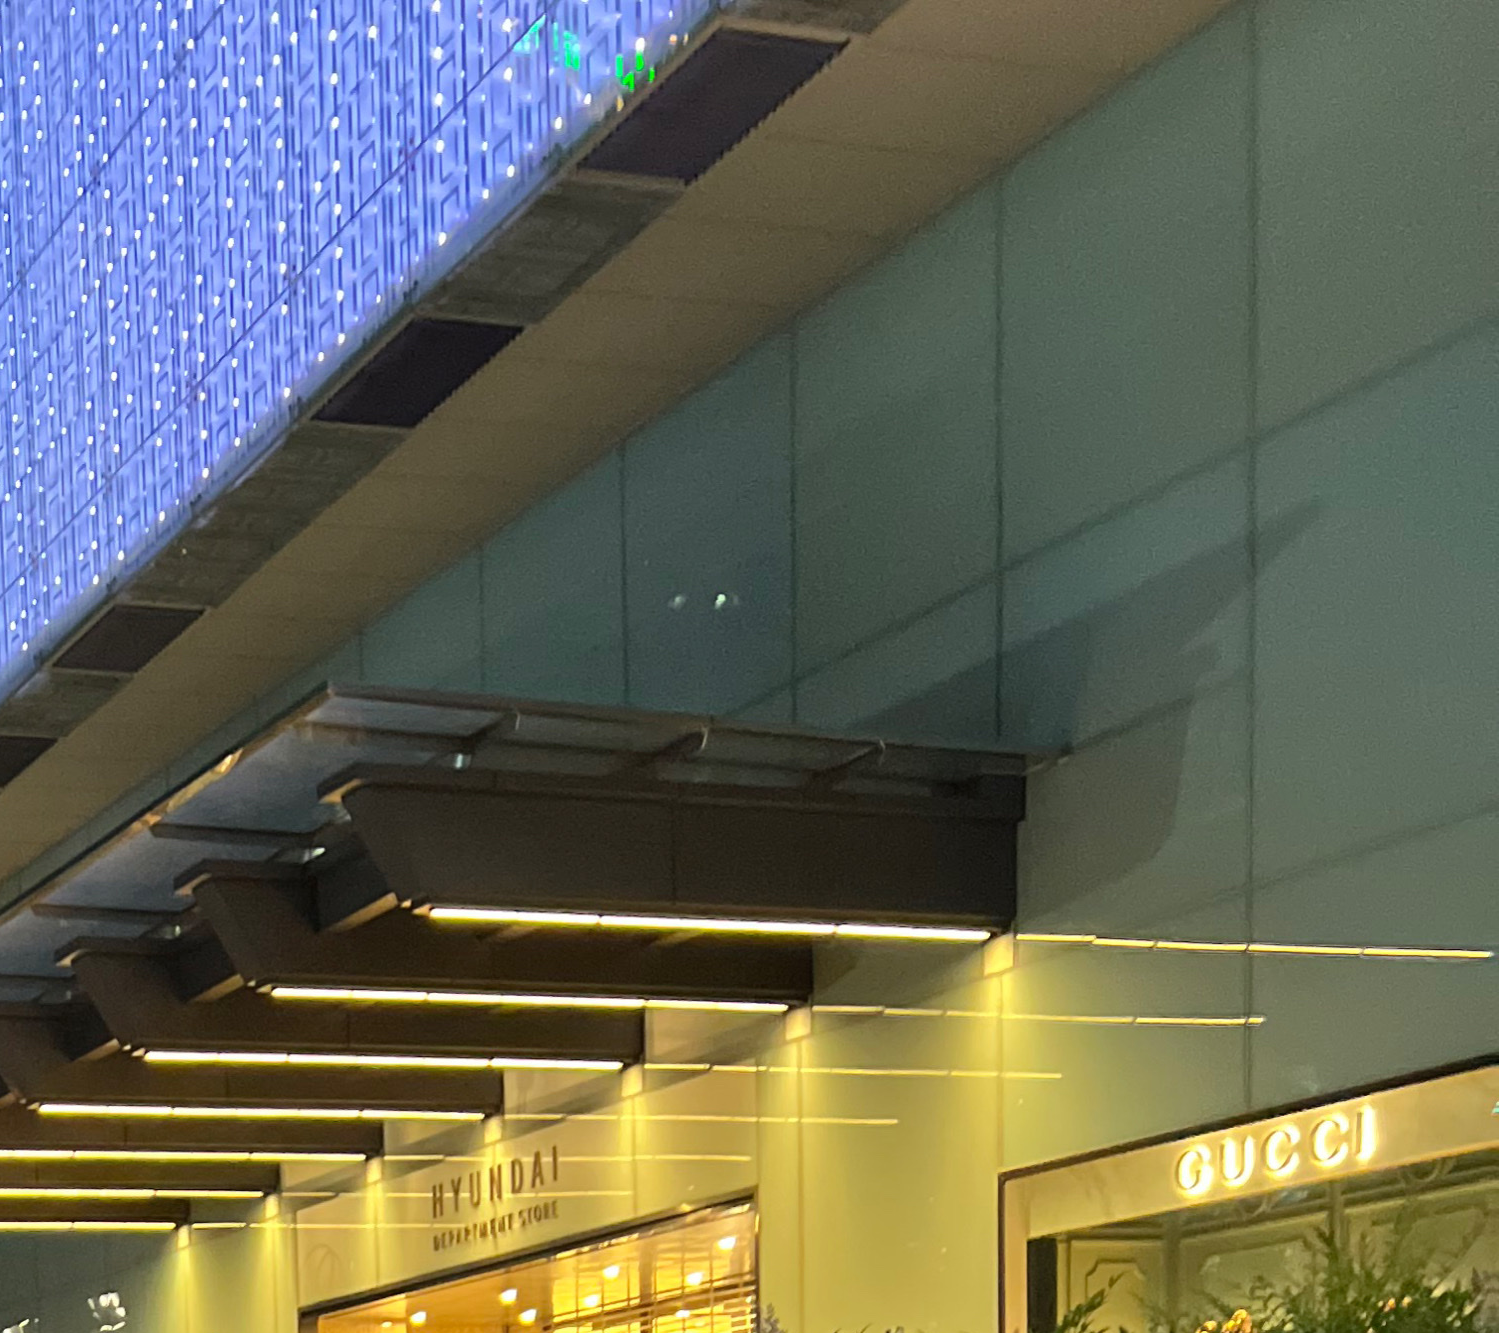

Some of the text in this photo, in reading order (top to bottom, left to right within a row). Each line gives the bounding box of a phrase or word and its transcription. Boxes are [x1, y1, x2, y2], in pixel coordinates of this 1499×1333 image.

[432, 1144, 558, 1219] HYUNDAI
[1174, 1102, 1378, 1198] GUCCI
[432, 1199, 558, 1252] DEPARTMENT STORE
